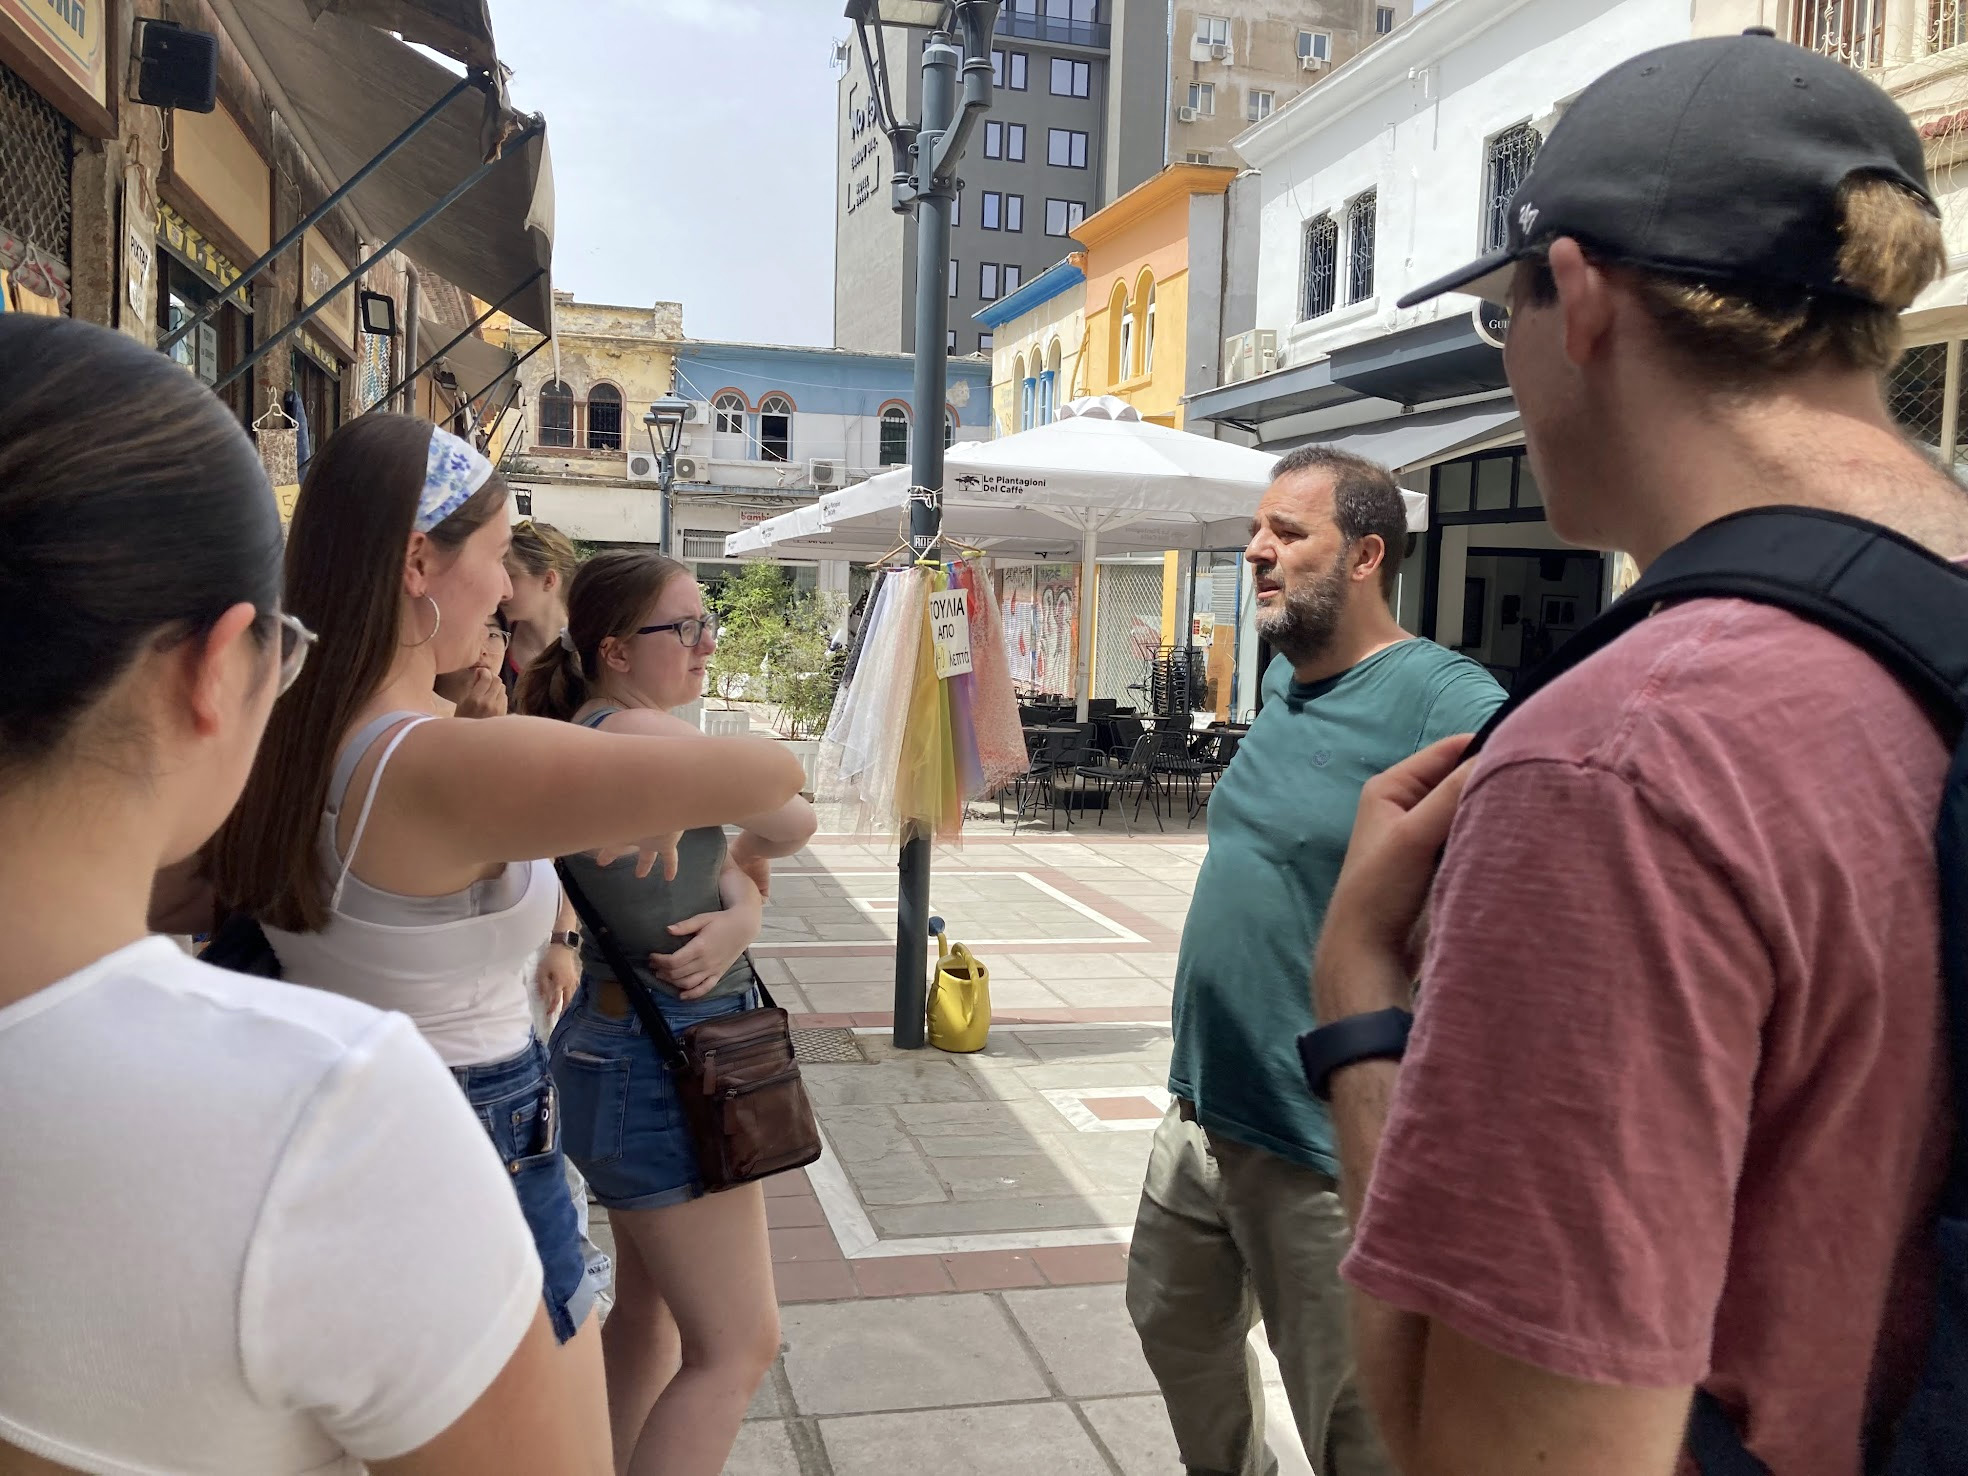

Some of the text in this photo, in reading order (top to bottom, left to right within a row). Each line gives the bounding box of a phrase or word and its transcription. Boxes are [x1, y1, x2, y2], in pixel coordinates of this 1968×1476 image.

[983, 475, 994, 483] Le
[983, 484, 998, 492] Del
[938, 623, 955, 640] ΑΠΟ
